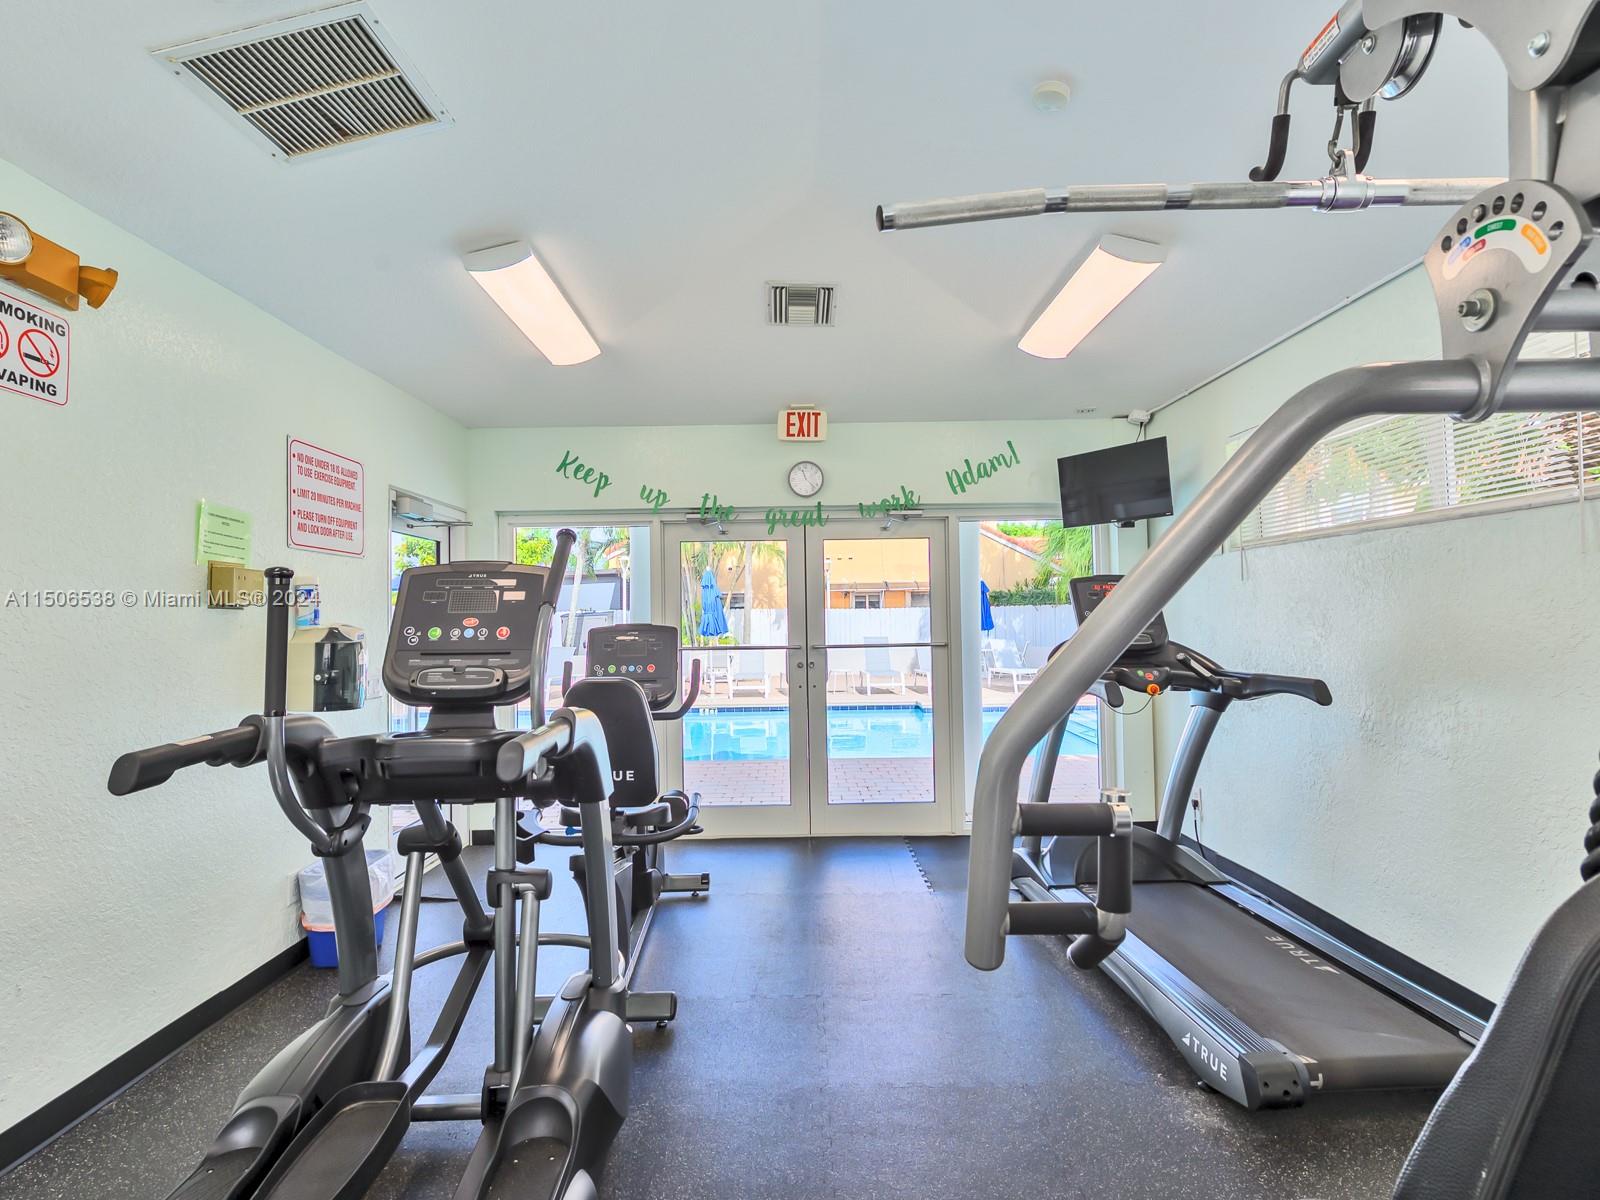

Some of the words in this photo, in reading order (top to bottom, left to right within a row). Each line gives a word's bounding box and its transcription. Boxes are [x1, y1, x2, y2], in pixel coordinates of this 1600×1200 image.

[785, 411, 821, 438] EXIT
[297, 452, 304, 463] NO
[305, 454, 314, 466] ONE
[315, 458, 329, 471] UNDER
[330, 463, 335, 473] 18
[335, 465, 340, 474] IS
[341, 467, 358, 480] ALLOWED
[297, 465, 303, 475] TO
[304, 467, 313, 478] USE
[314, 470, 333, 484] EXERCISE
[297, 488, 309, 499] LIMIT
[310, 491, 316, 501] 20
[317, 493, 335, 506] MINUTES
[336, 497, 344, 508] PER
[555, 449, 614, 498] Keep
[639, 483, 670, 514] up
[699, 492, 739, 522] the
[765, 501, 830, 536] great
[858, 485, 921, 519] work
[945, 440, 1021, 496] Adam!
[297, 509, 314, 522] PLEASE
[315, 513, 327, 524] TURN
[327, 515, 335, 526] OFF
[336, 517, 358, 530] EQUIPMENT
[297, 522, 307, 533] AND
[308, 524, 319, 535] LOCK
[320, 526, 332, 537] DOOR
[333, 529, 345, 539] AFTER
[1192, 1036, 1228, 1082] TRUE
